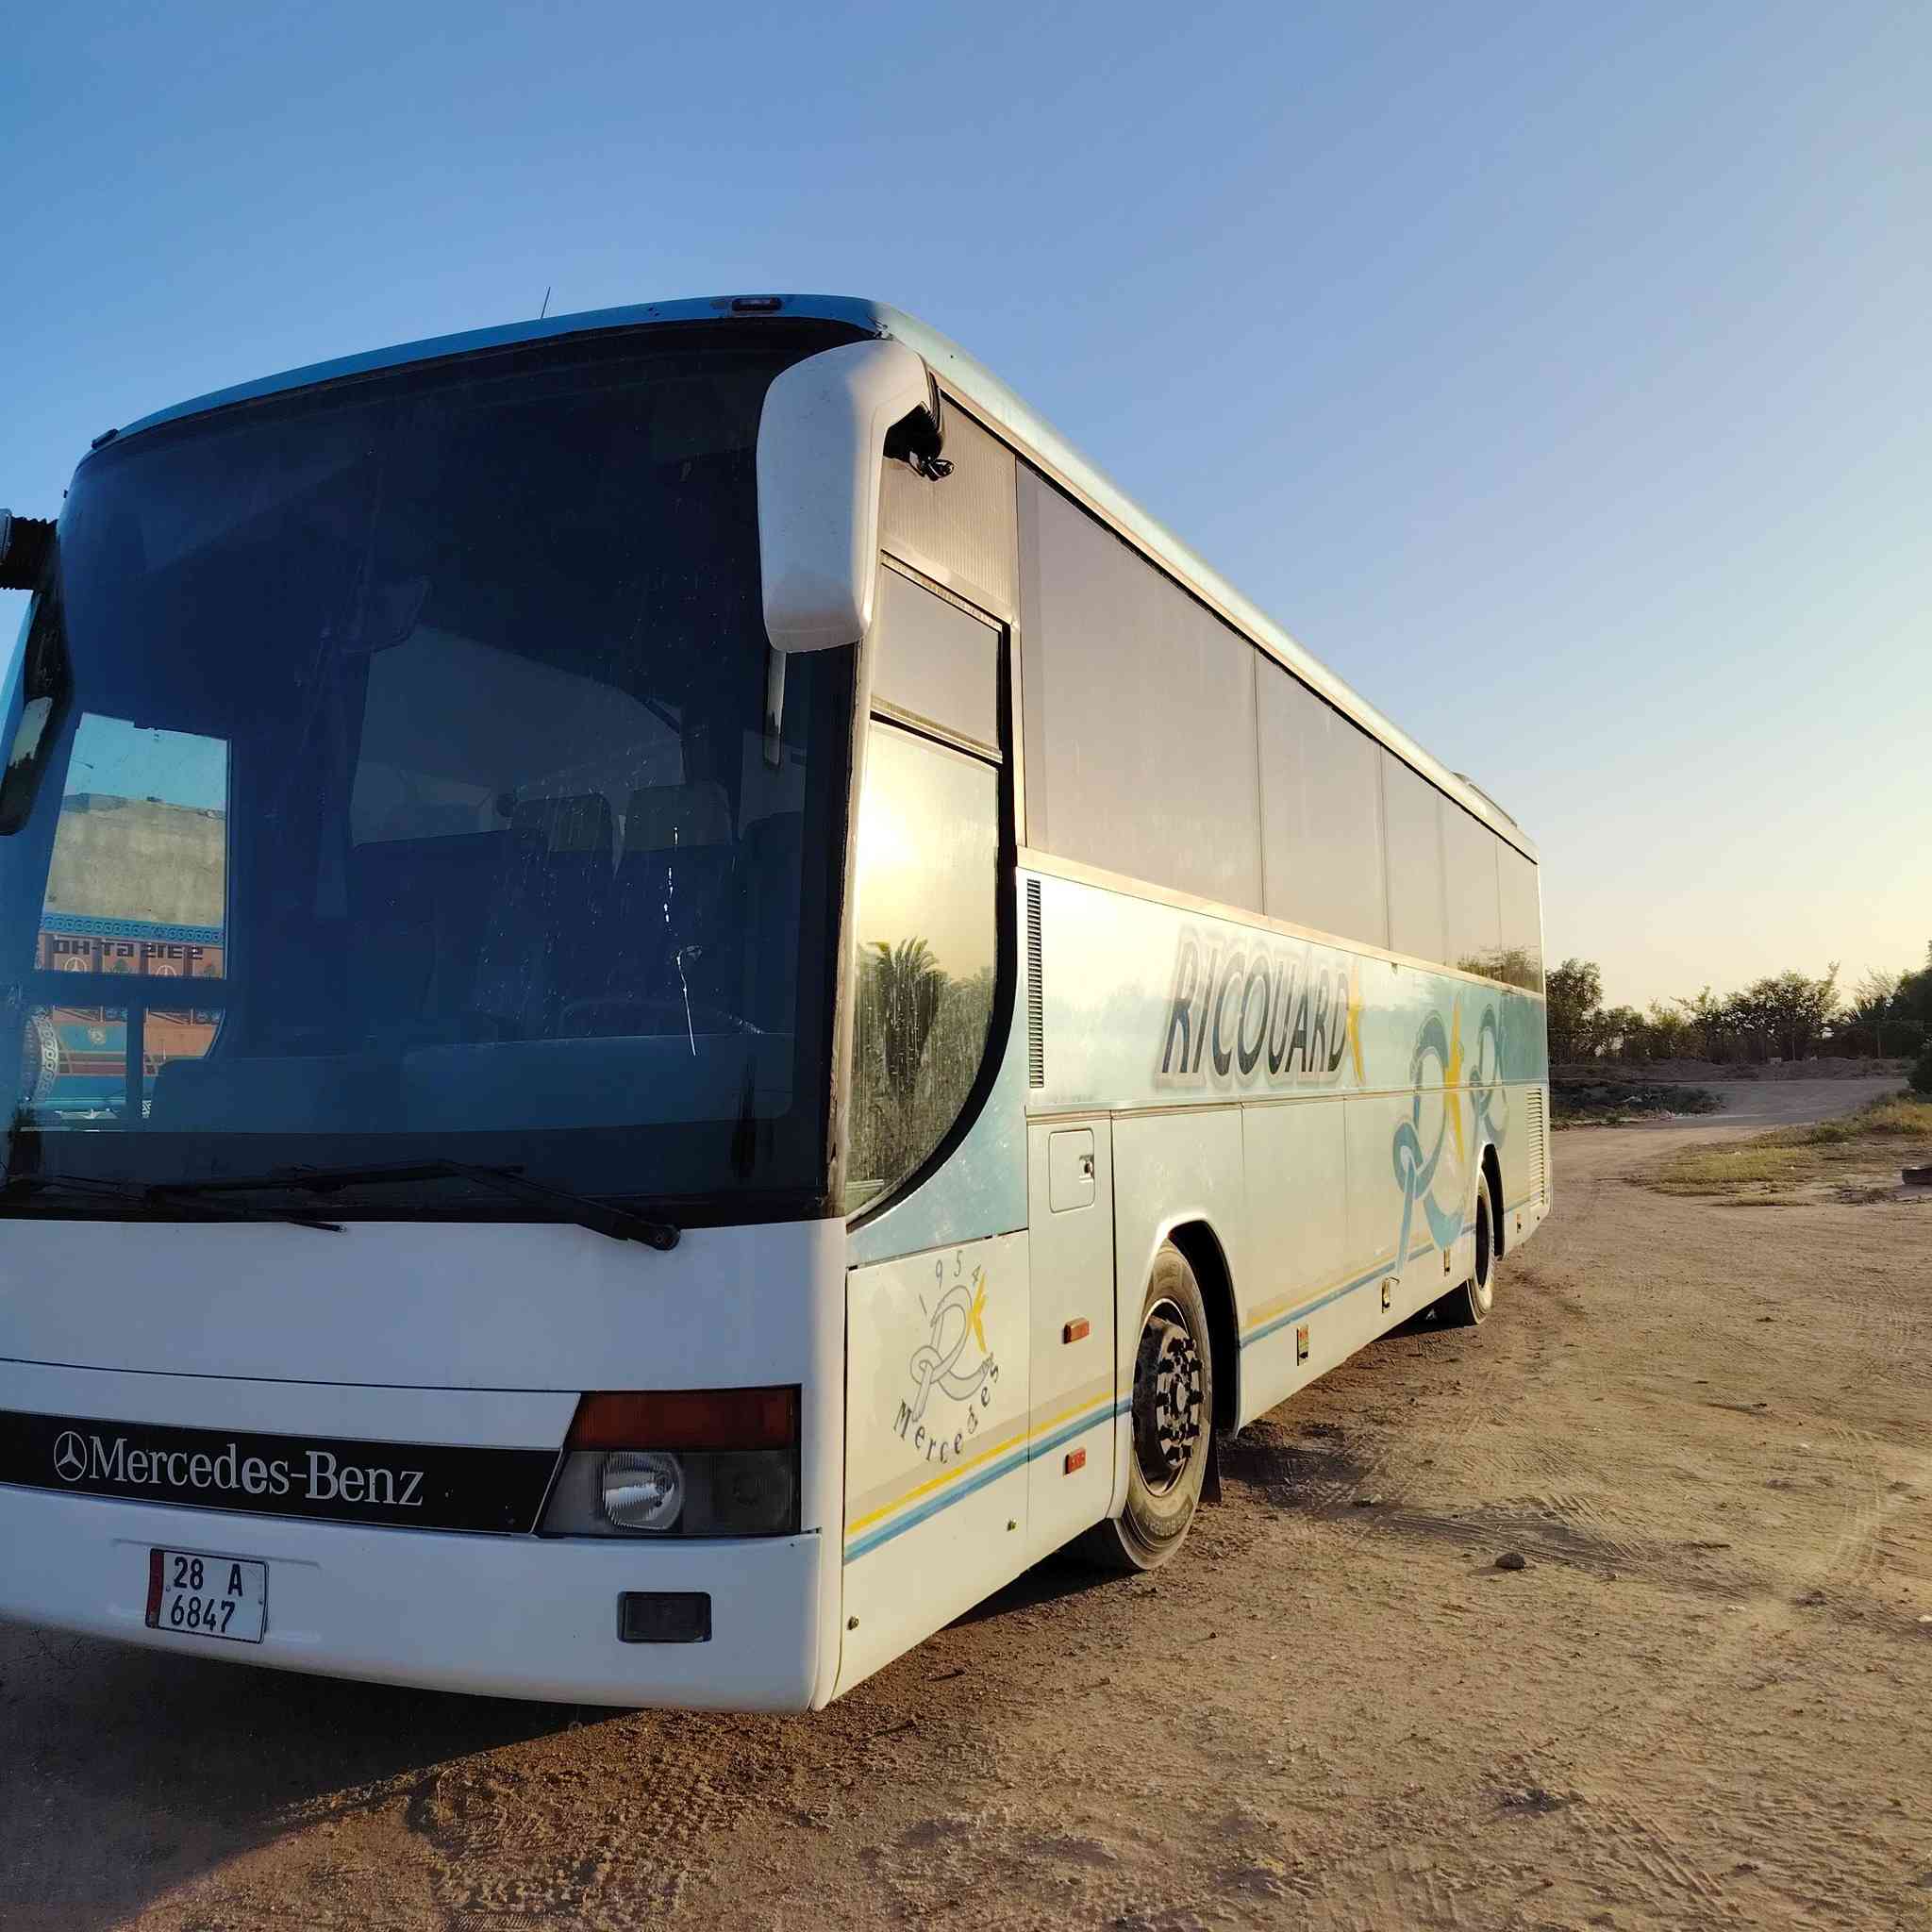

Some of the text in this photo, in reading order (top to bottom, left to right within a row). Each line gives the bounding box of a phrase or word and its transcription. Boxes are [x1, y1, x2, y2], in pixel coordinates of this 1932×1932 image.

[1160, 939, 1349, 1076] RICOUARD
[89, 1435, 425, 1507] Mercedes-Benz
[174, 1557, 243, 1597] 28 A
[171, 1594, 236, 1634] 6847
